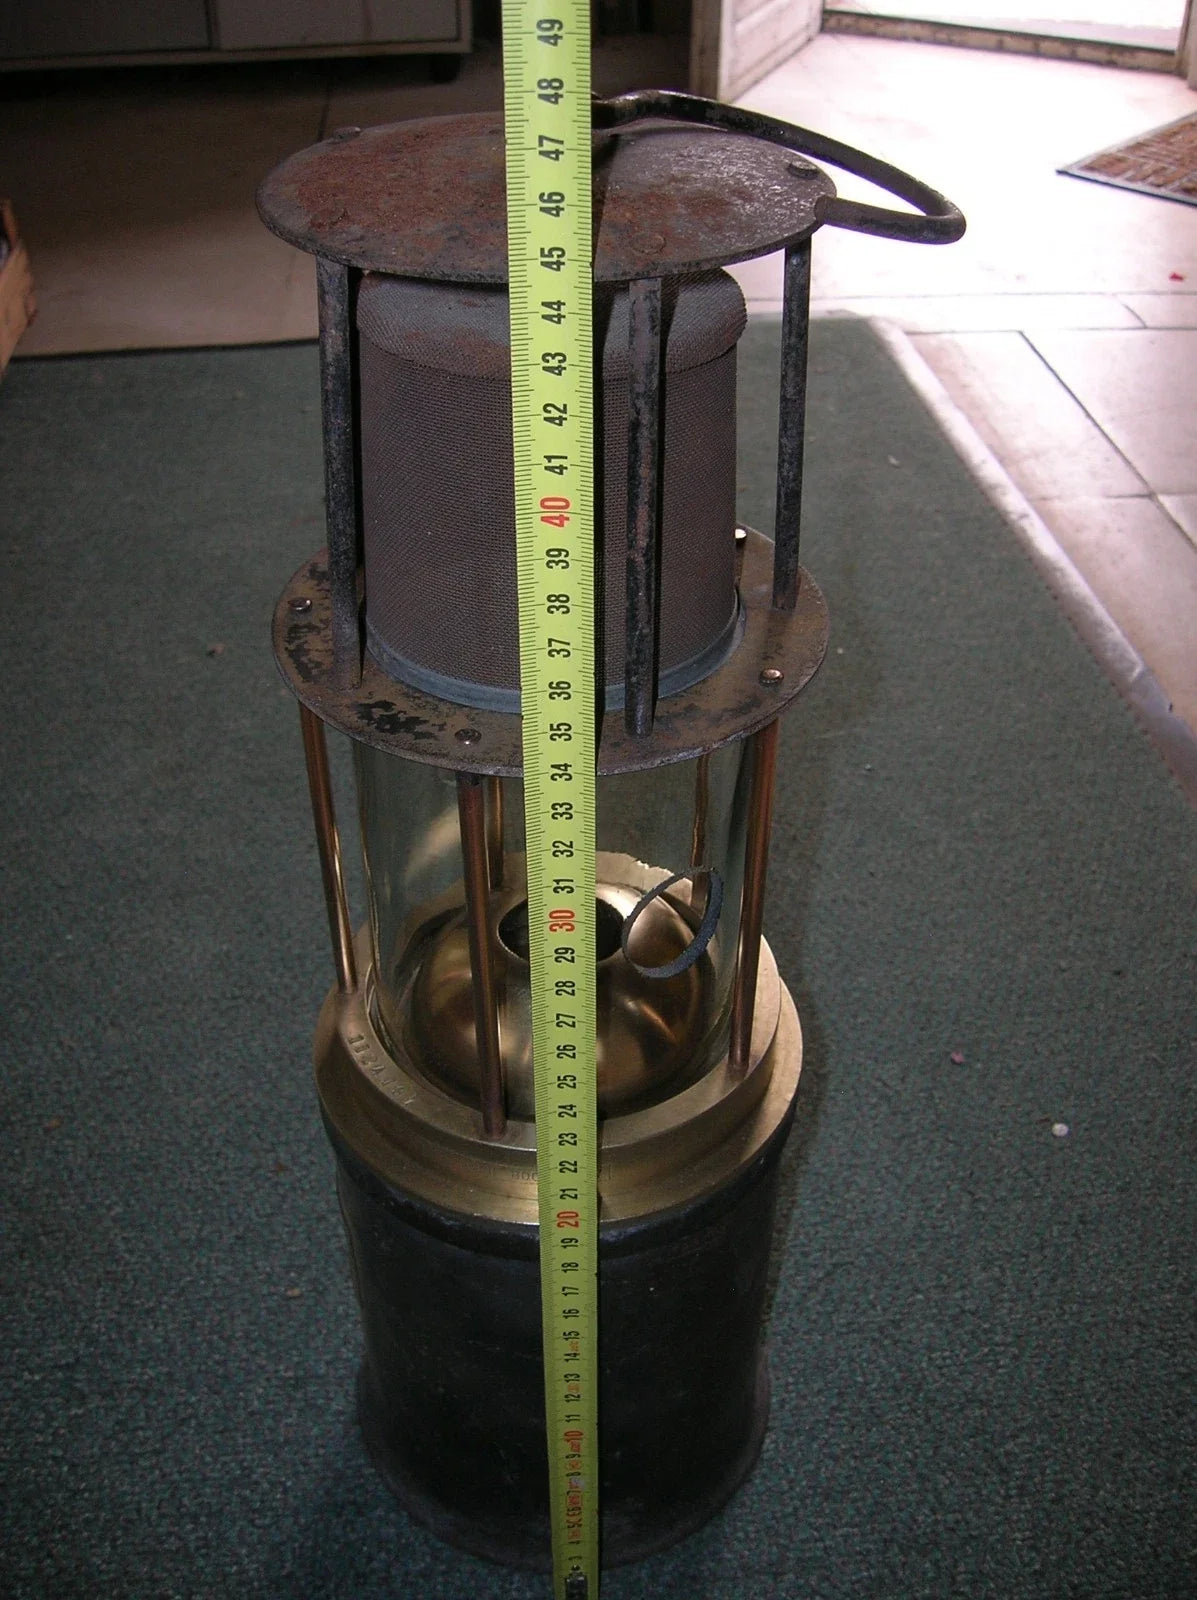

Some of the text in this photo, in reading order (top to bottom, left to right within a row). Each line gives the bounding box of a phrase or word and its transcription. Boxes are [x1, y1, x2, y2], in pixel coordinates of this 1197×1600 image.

[535, 18, 563, 47] 49
[537, 78, 564, 105] 48
[538, 135, 564, 161] 47
[539, 192, 565, 217] 46
[540, 246, 566, 272] 45
[541, 300, 566, 325] 44
[541, 352, 567, 376] 43
[543, 403, 567, 426] 42
[544, 455, 568, 476] 41
[540, 497, 571, 528] 40
[546, 548, 570, 569] 39
[547, 594, 570, 615] 38
[548, 638, 571, 658] 37
[549, 681, 571, 701] 36
[550, 722, 572, 742] 35
[551, 763, 573, 781] 34
[551, 802, 573, 820] 33
[552, 840, 574, 858] 32
[553, 878, 575, 894] 31
[549, 910, 575, 932] 30
[554, 947, 575, 963] 29
[555, 980, 576, 996] 28
[556, 1013, 576, 1028] 27
[556, 1044, 576, 1059] 26
[557, 1074, 576, 1089] 25
[558, 1104, 577, 1118] 24
[558, 1132, 577, 1146] 23
[559, 1160, 577, 1173] 22
[560, 1188, 578, 1200] 21
[557, 1211, 579, 1228] 20
[561, 1238, 579, 1249] 19
[561, 1262, 579, 1273] 18
[562, 1286, 579, 1296] 17
[563, 1308, 580, 1319] 16
[563, 1330, 580, 1341] 15
[563, 1352, 580, 1362] 14
[564, 1373, 580, 1383] 13
[564, 1393, 581, 1403] 12
[565, 1414, 580, 1423] 11
[564, 1430, 583, 1443] 10
